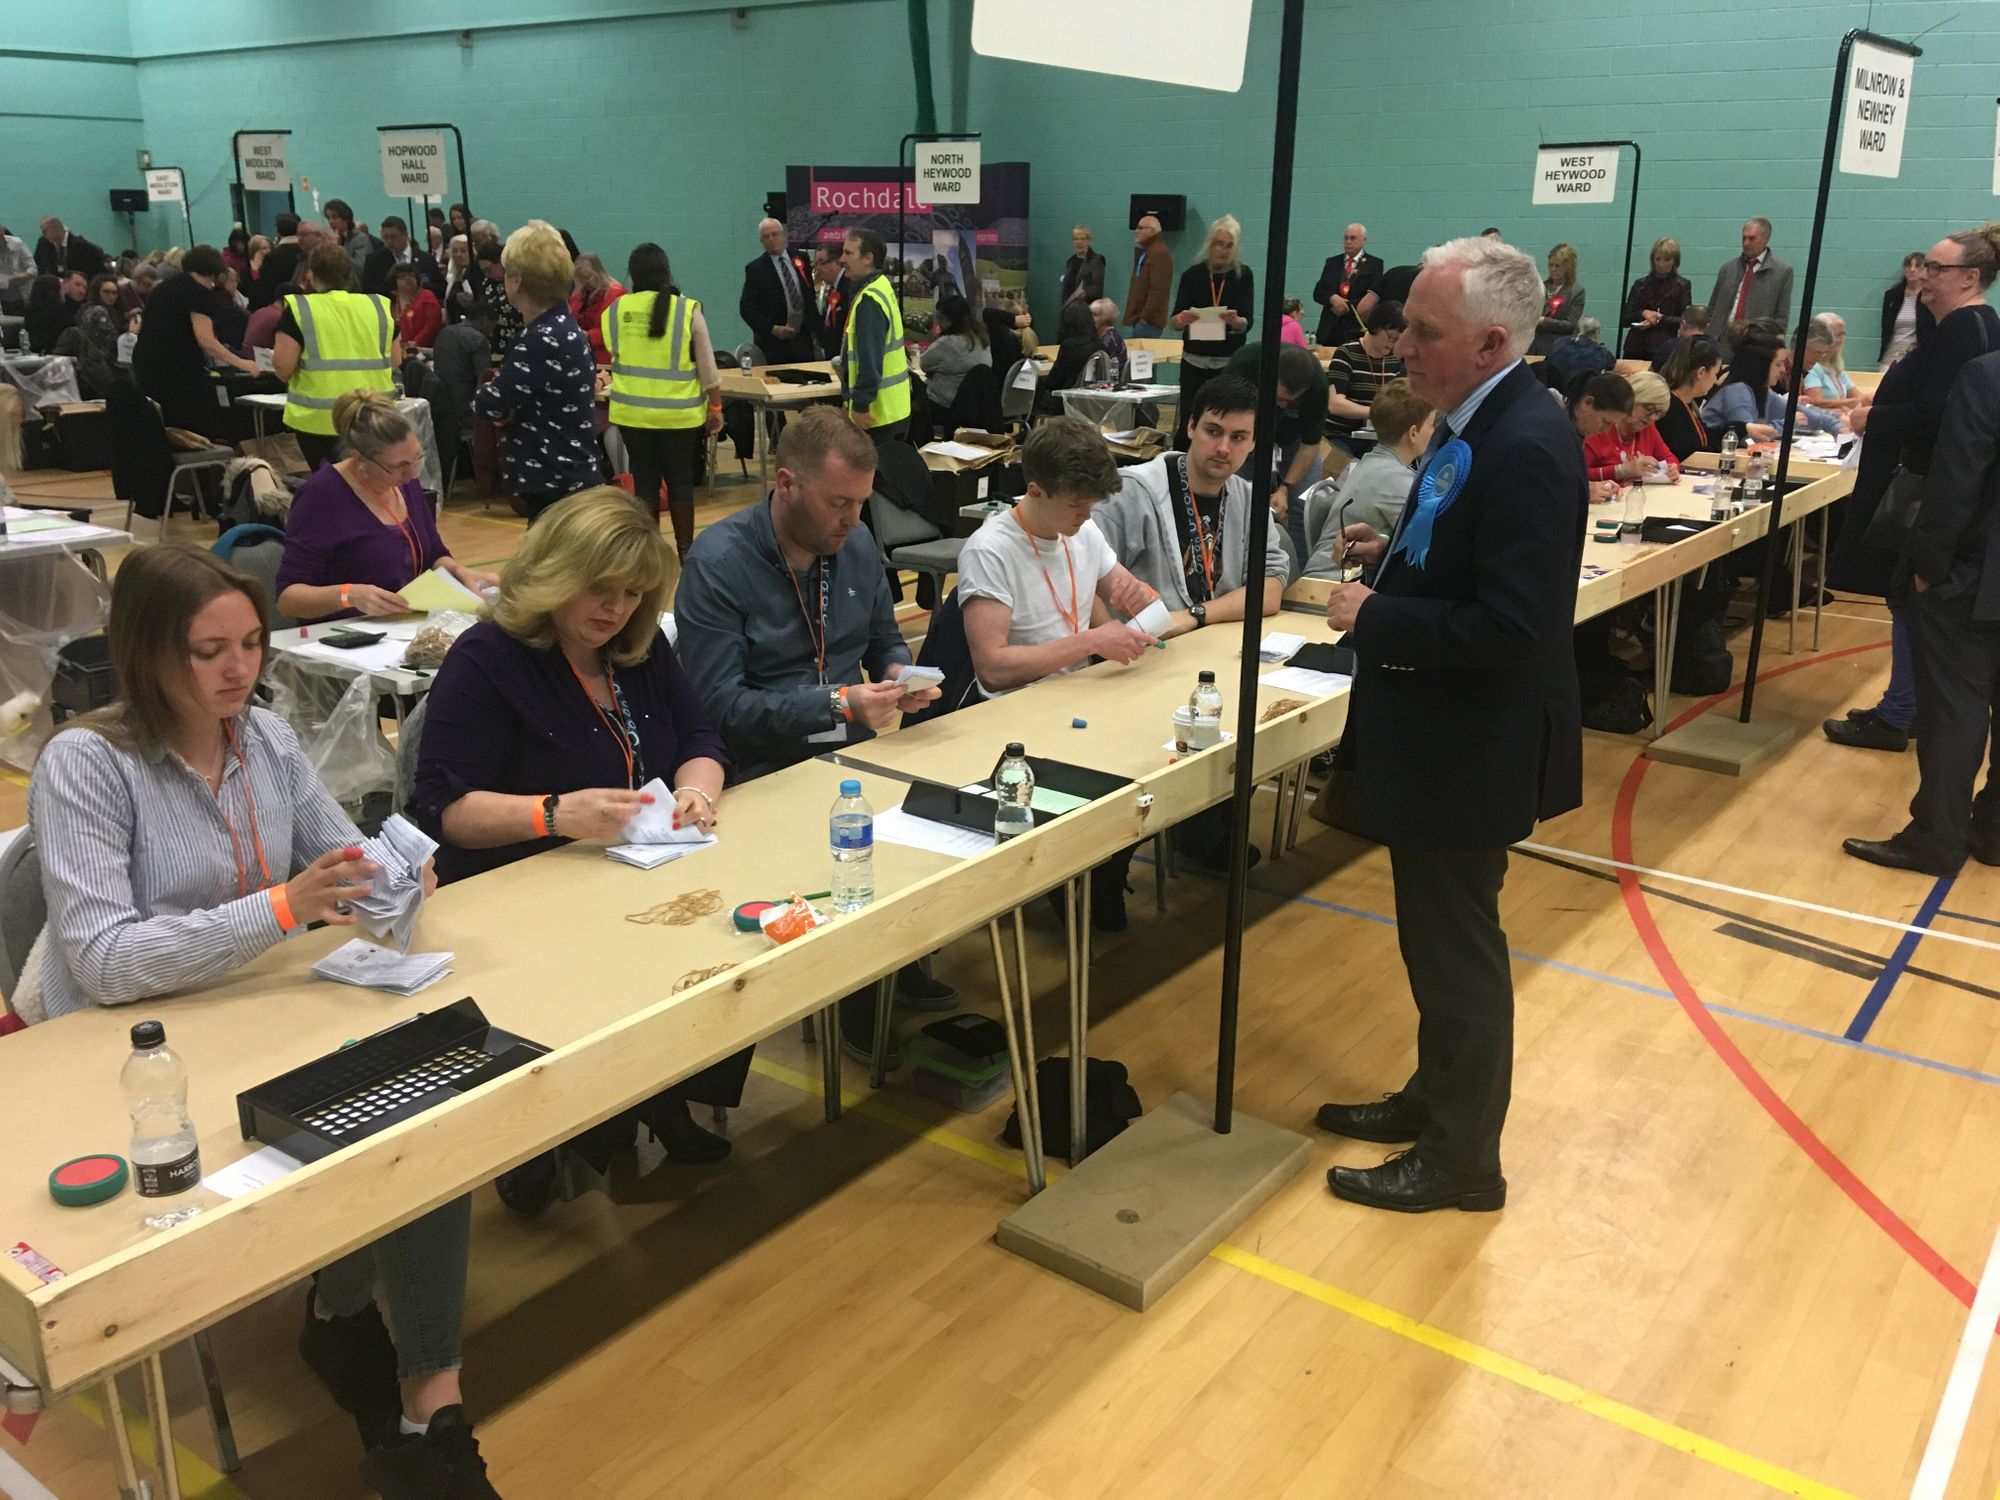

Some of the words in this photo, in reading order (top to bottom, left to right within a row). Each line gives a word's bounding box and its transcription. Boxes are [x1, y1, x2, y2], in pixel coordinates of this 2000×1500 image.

[1855, 67, 1897, 97] MILNROW
[1898, 78, 1905, 98] &
[1857, 98, 1896, 125] NEWHEY
[1859, 128, 1886, 152] WARD
[253, 145, 272, 156] WEST
[387, 145, 437, 156] HOPWOOD
[245, 158, 284, 168] MIDDLETON
[931, 153, 964, 164] NORTH
[1560, 156, 1594, 167] WEST
[401, 159, 426, 170] HALL
[255, 171, 276, 181] WARD
[400, 172, 429, 183] WARD
[923, 167, 972, 178] HEYWOOD
[1545, 168, 1606, 181] HEYWOOD
[932, 181, 961, 192] WARD
[1556, 182, 1592, 193] WARD
